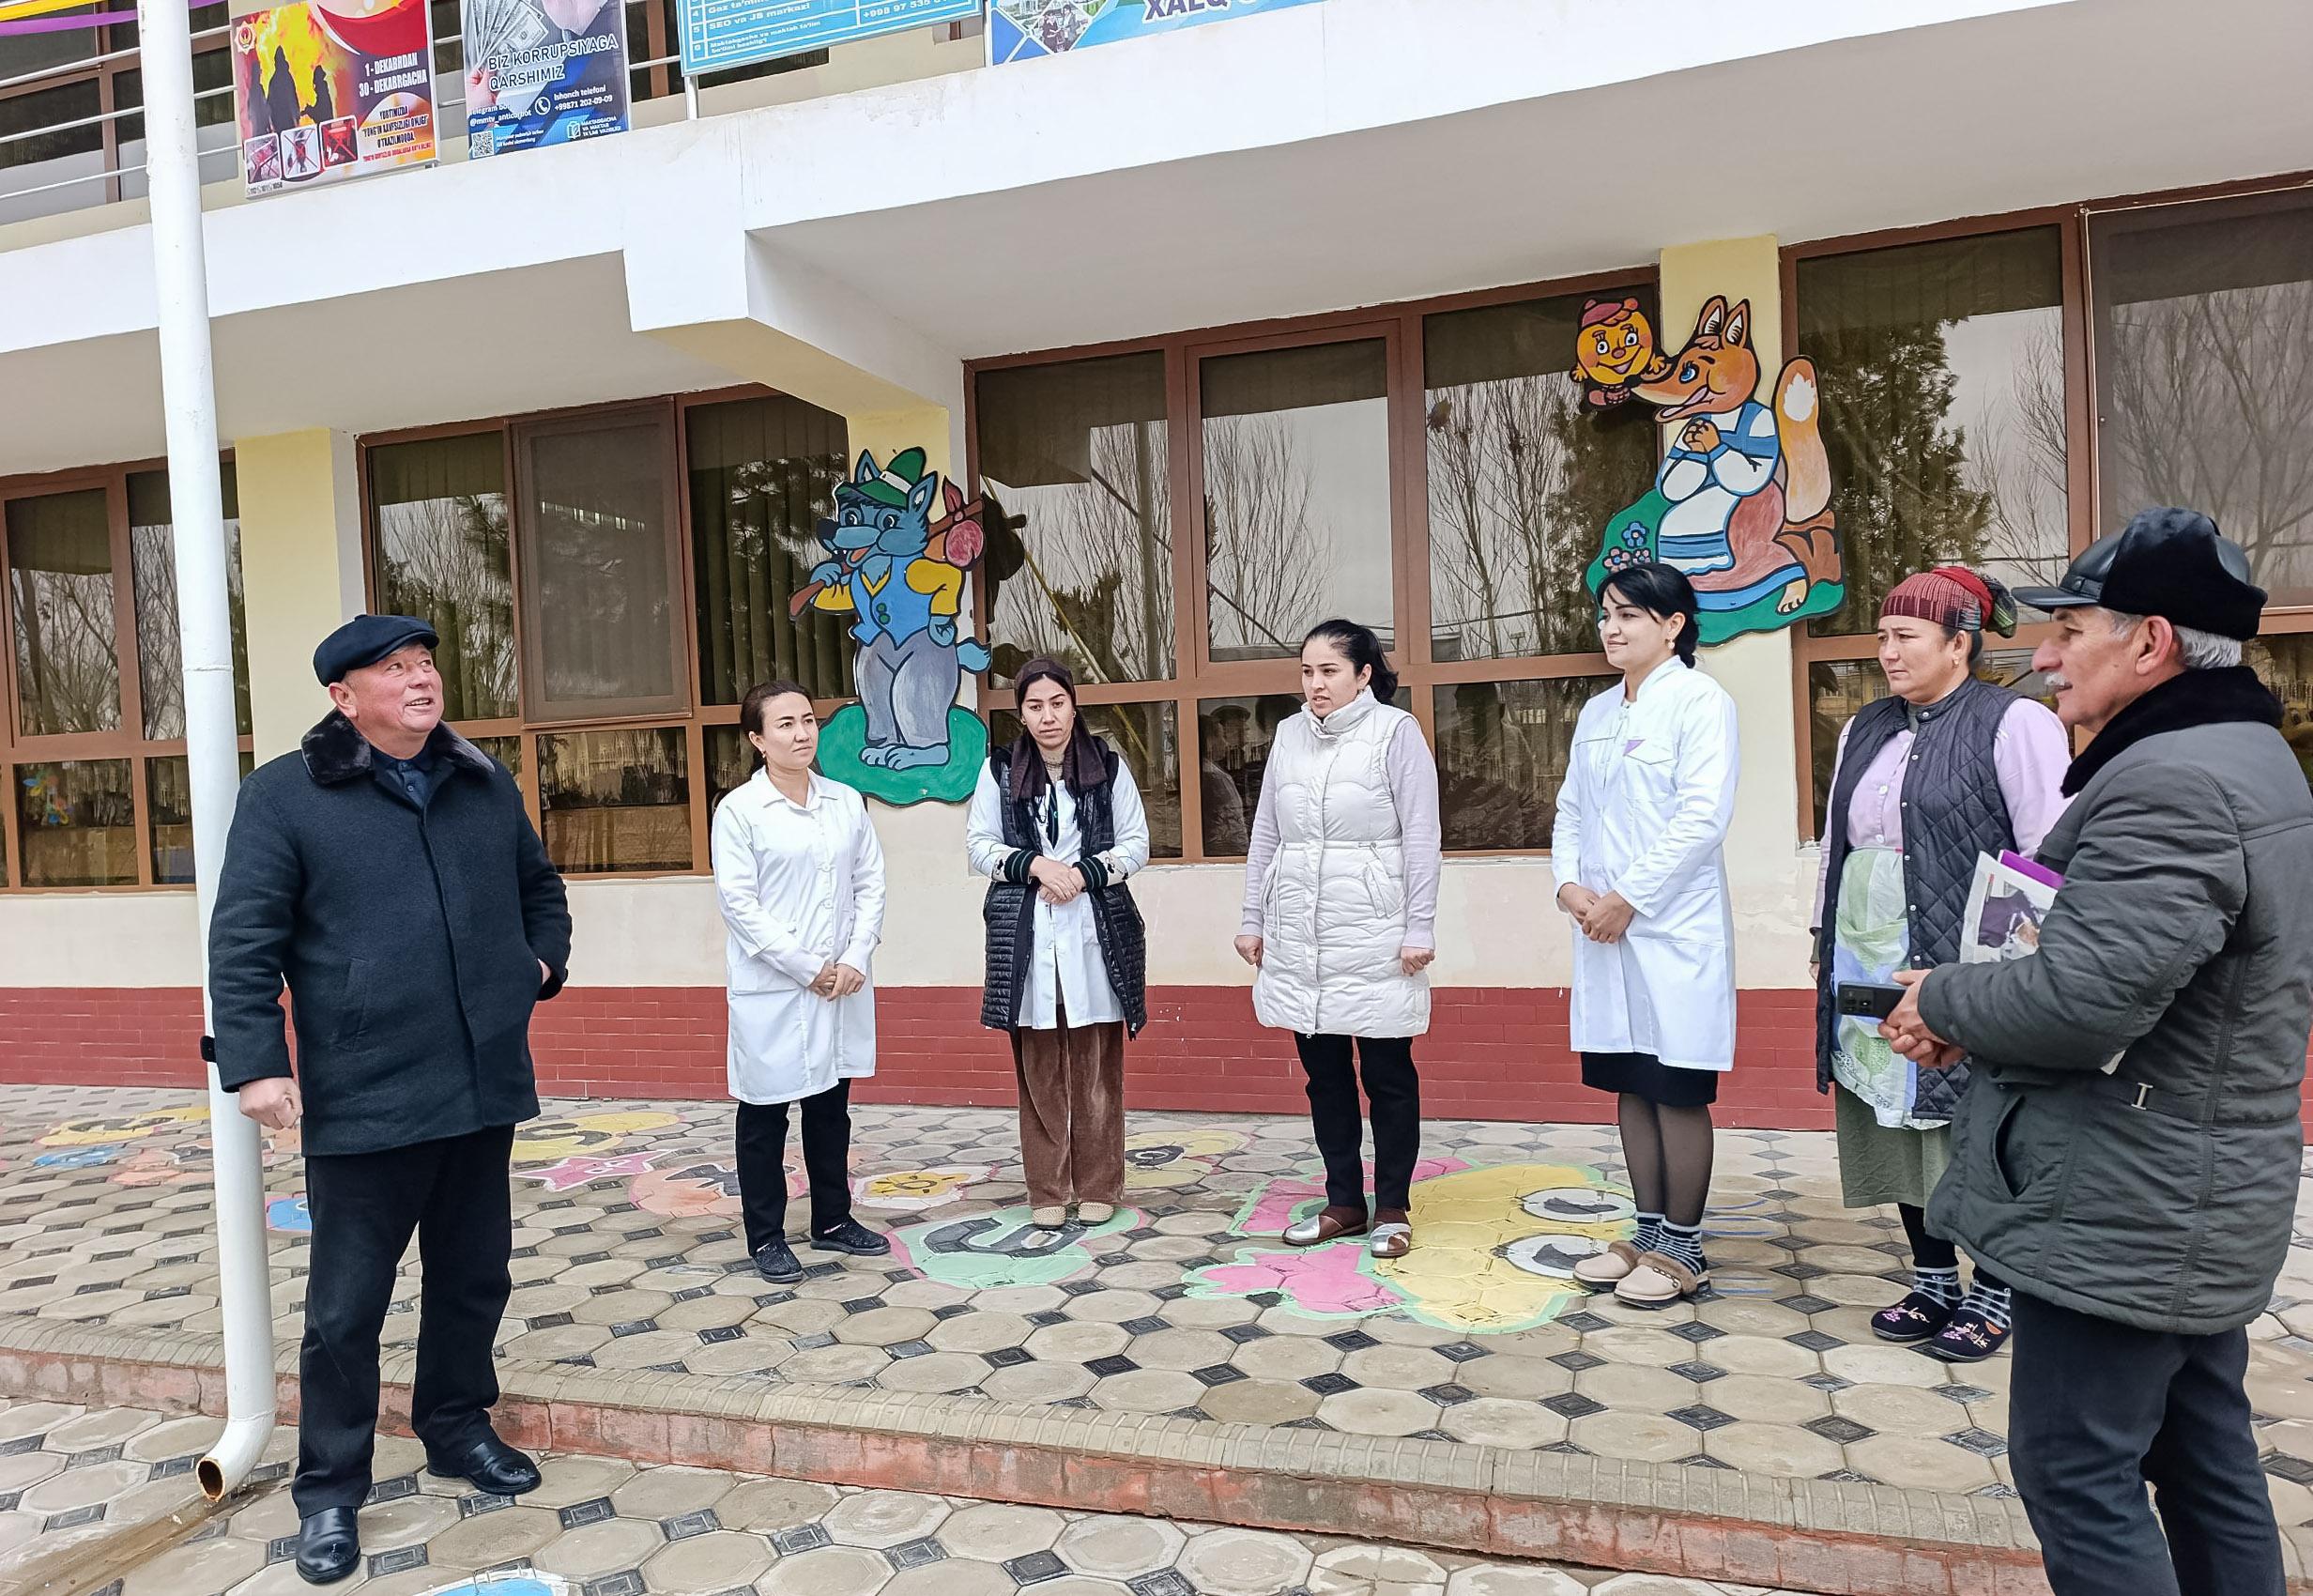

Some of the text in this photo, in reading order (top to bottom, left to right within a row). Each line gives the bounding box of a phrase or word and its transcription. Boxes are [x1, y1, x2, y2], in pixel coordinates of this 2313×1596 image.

[708, 6, 728, 14] Gaz
[766, 3, 810, 18] markazi
[894, 3, 908, 11] 97
[1145, 0, 1227, 20] XAL
[488, 34, 619, 70] BIZ KORRUPSIYAGA
[490, 65, 564, 91] QARSHIMIZ
[554, 84, 607, 101] Ishonch telefoni
[468, 104, 498, 115] elegram
[554, 94, 613, 112] +99871 202-09-09
